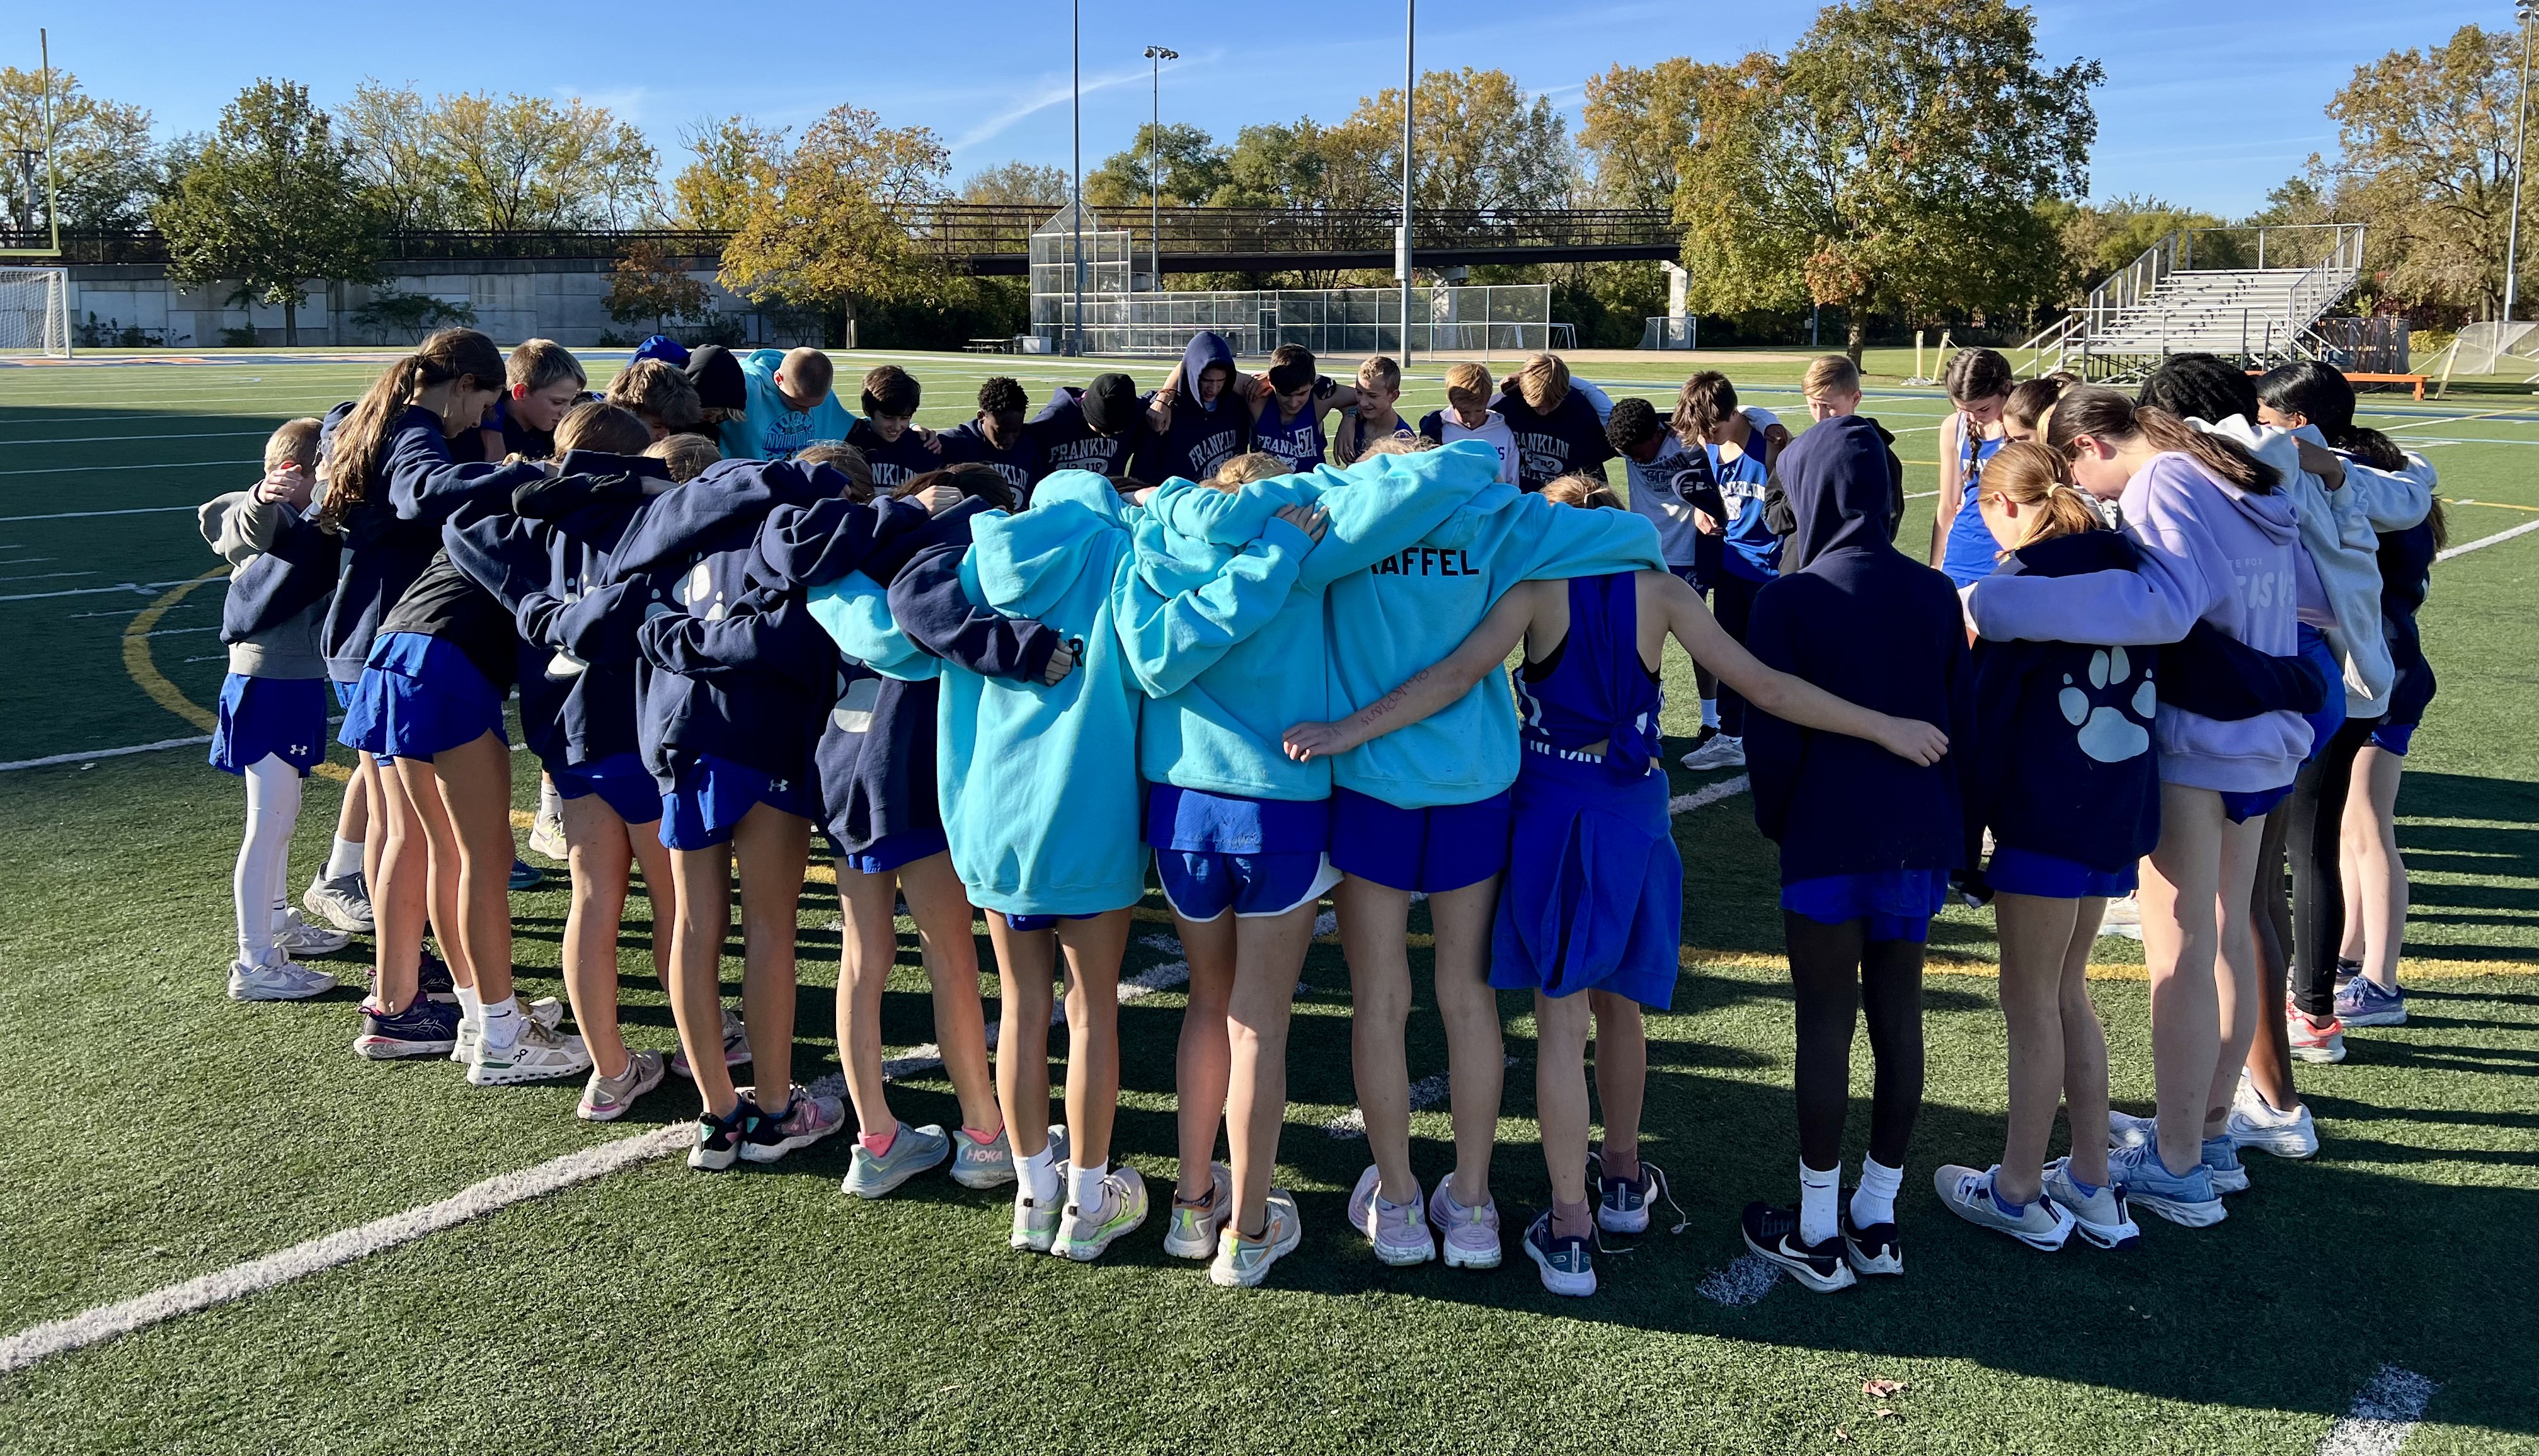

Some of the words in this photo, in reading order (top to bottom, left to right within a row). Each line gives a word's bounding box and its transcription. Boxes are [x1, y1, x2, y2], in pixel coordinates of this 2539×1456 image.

[1048, 438, 1118, 463] FRANKLIN
[1298, 428, 1312, 453] 57
[1513, 432, 1569, 460] ANKLIN
[1370, 547, 1480, 576] AFFEL
[966, 1149, 1003, 1163] HOKA
